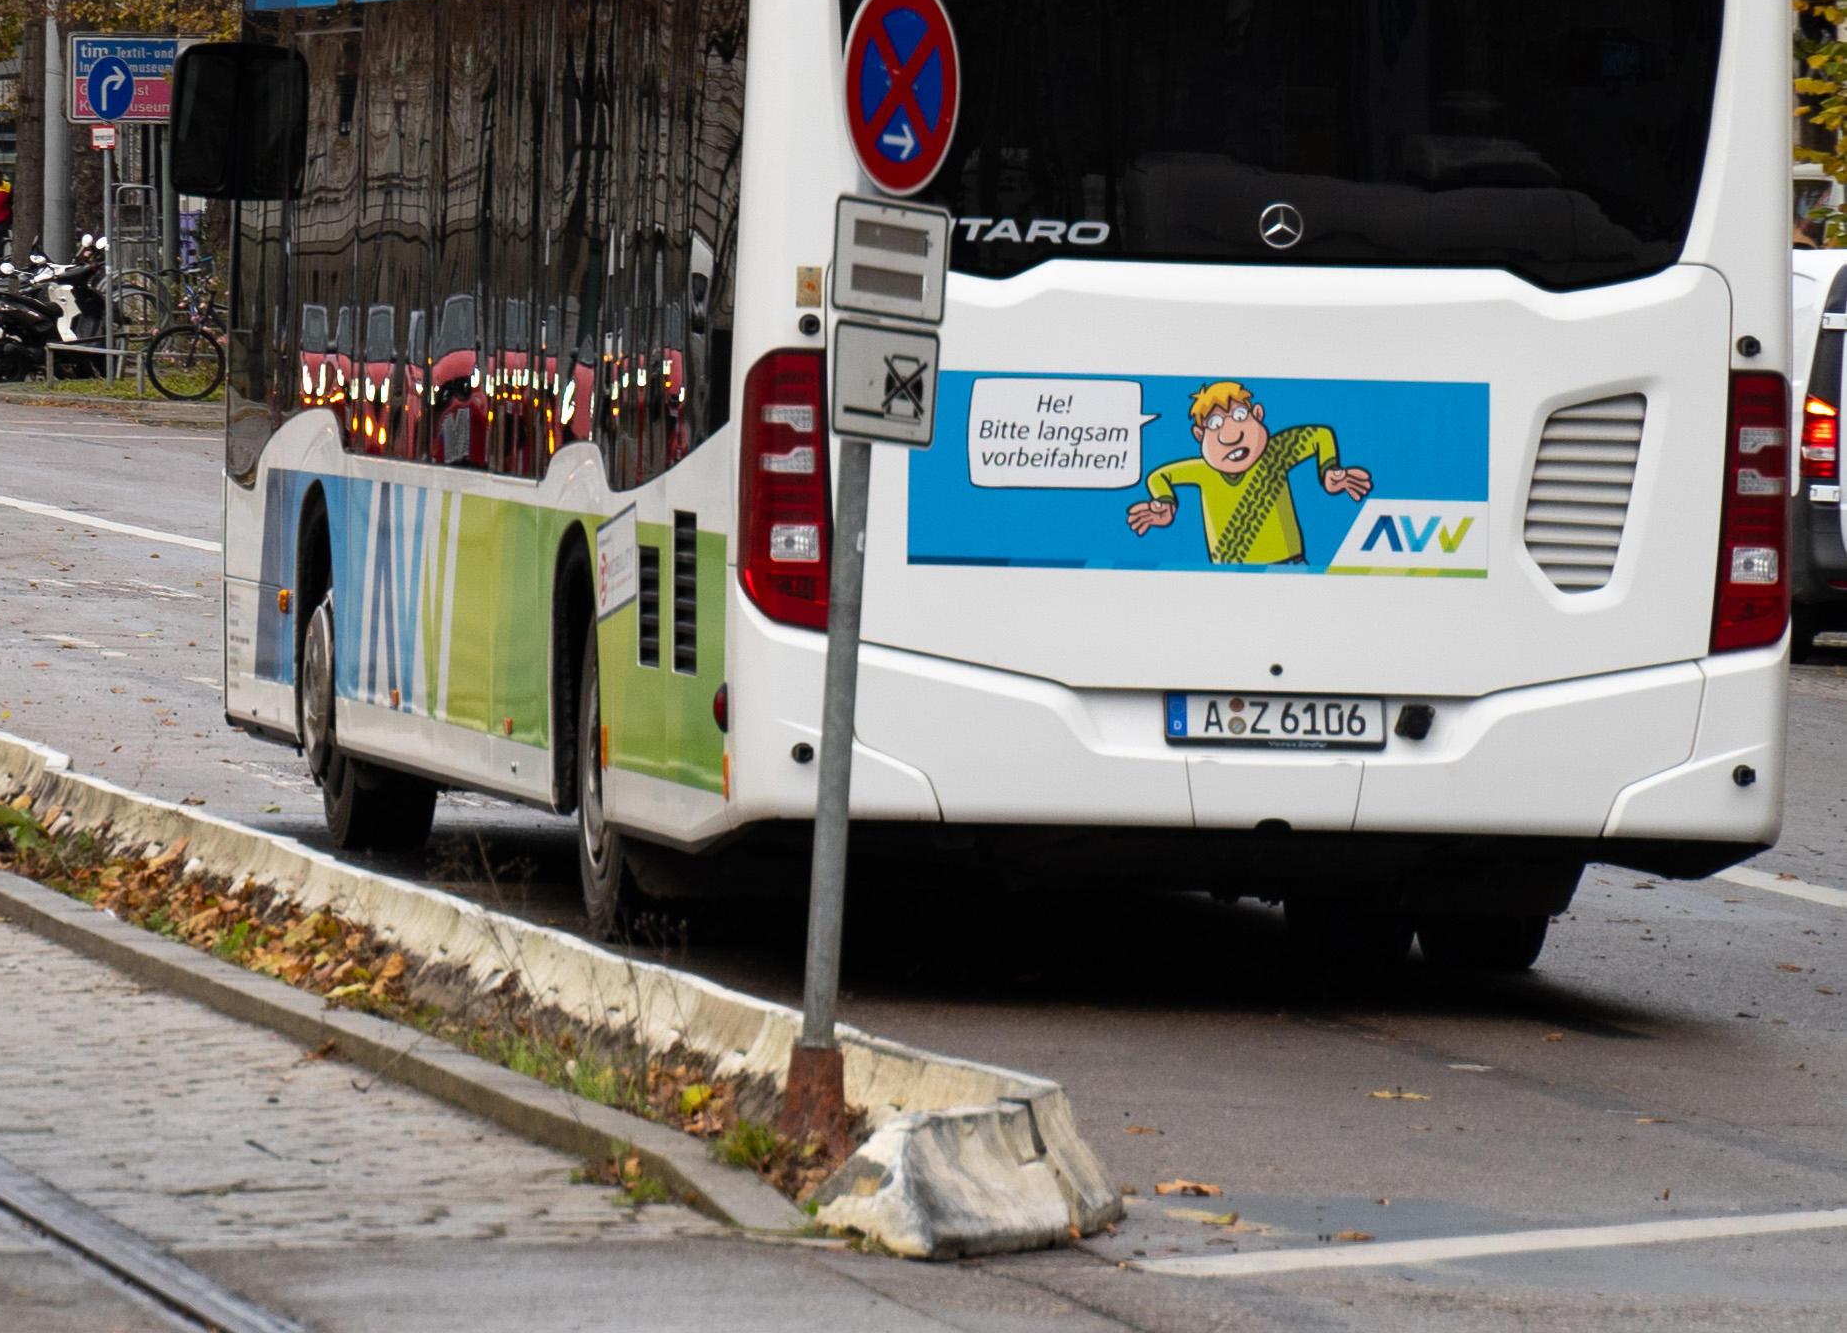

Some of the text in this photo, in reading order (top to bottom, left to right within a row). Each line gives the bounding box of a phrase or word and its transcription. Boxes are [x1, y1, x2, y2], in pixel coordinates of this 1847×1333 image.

[81, 42, 174, 58] tim Textil- und
[1037, 394, 1073, 414] He!
[979, 420, 1129, 446] Bitte langsam
[981, 447, 1128, 470] vorbeifahren!
[1360, 514, 1475, 554] AVV
[1204, 700, 1223, 733] A
[1250, 701, 1270, 734] Z
[1280, 703, 1367, 734] 6106
